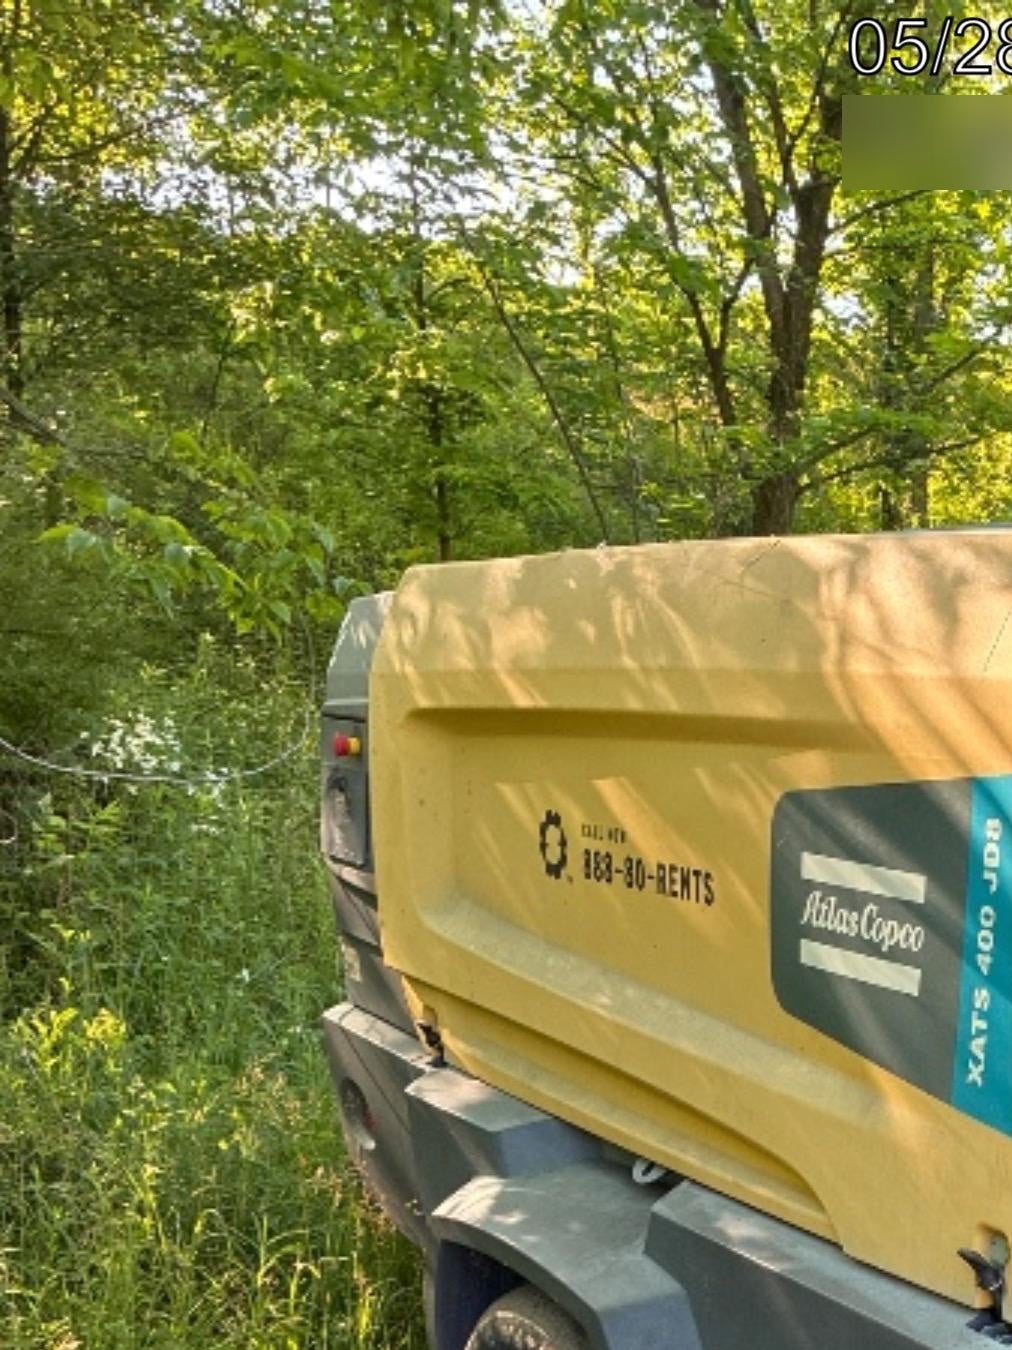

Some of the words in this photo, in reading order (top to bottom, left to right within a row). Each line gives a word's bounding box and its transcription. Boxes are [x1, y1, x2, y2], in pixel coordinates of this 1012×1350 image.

[800, 890, 859, 937] Atlas
[860, 902, 925, 952] Copco
[977, 905, 997, 976] 400
[966, 987, 992, 1087] XATS
